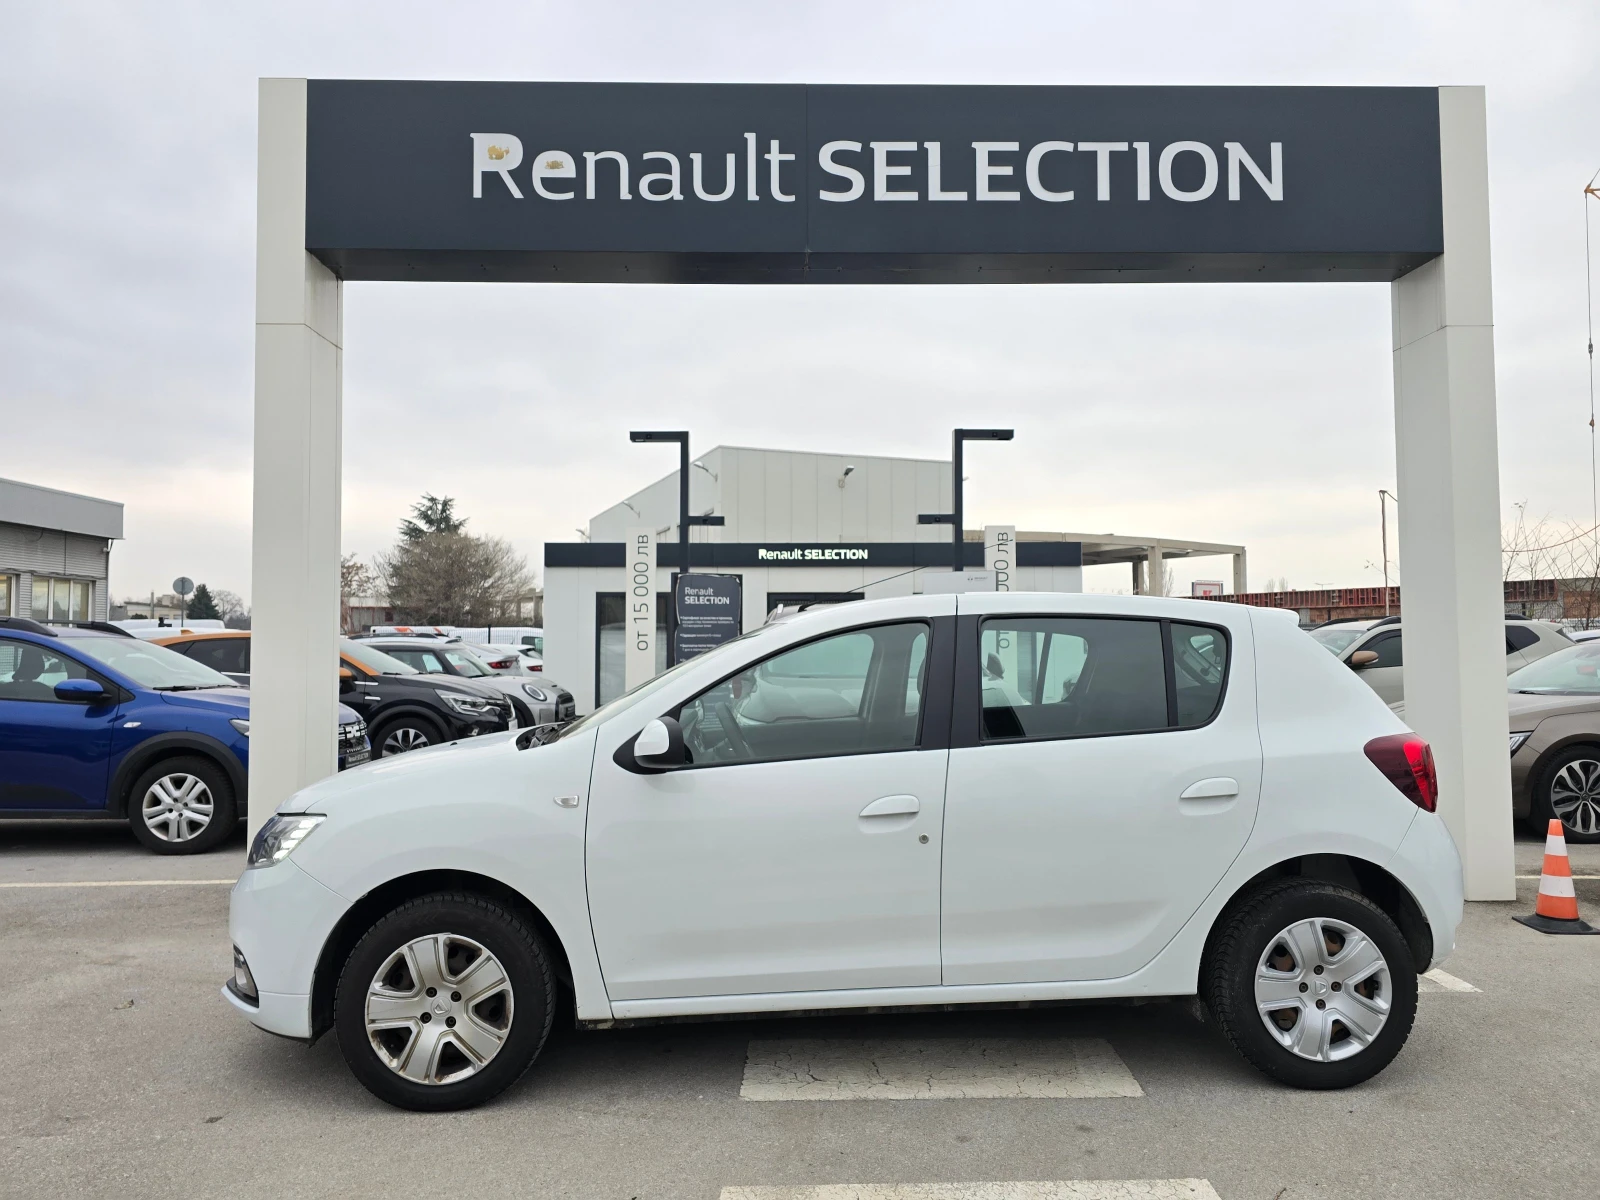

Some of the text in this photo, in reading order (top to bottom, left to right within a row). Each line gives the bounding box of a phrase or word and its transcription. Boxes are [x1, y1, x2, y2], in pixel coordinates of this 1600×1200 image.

[470, 133, 1284, 202] Renault SELECTION
[758, 548, 869, 560] Renault SELECTION
[634, 562, 649, 596] 000
[684, 587, 714, 595] Renault
[684, 596, 730, 605] SELECTION
[634, 603, 649, 624] 15
